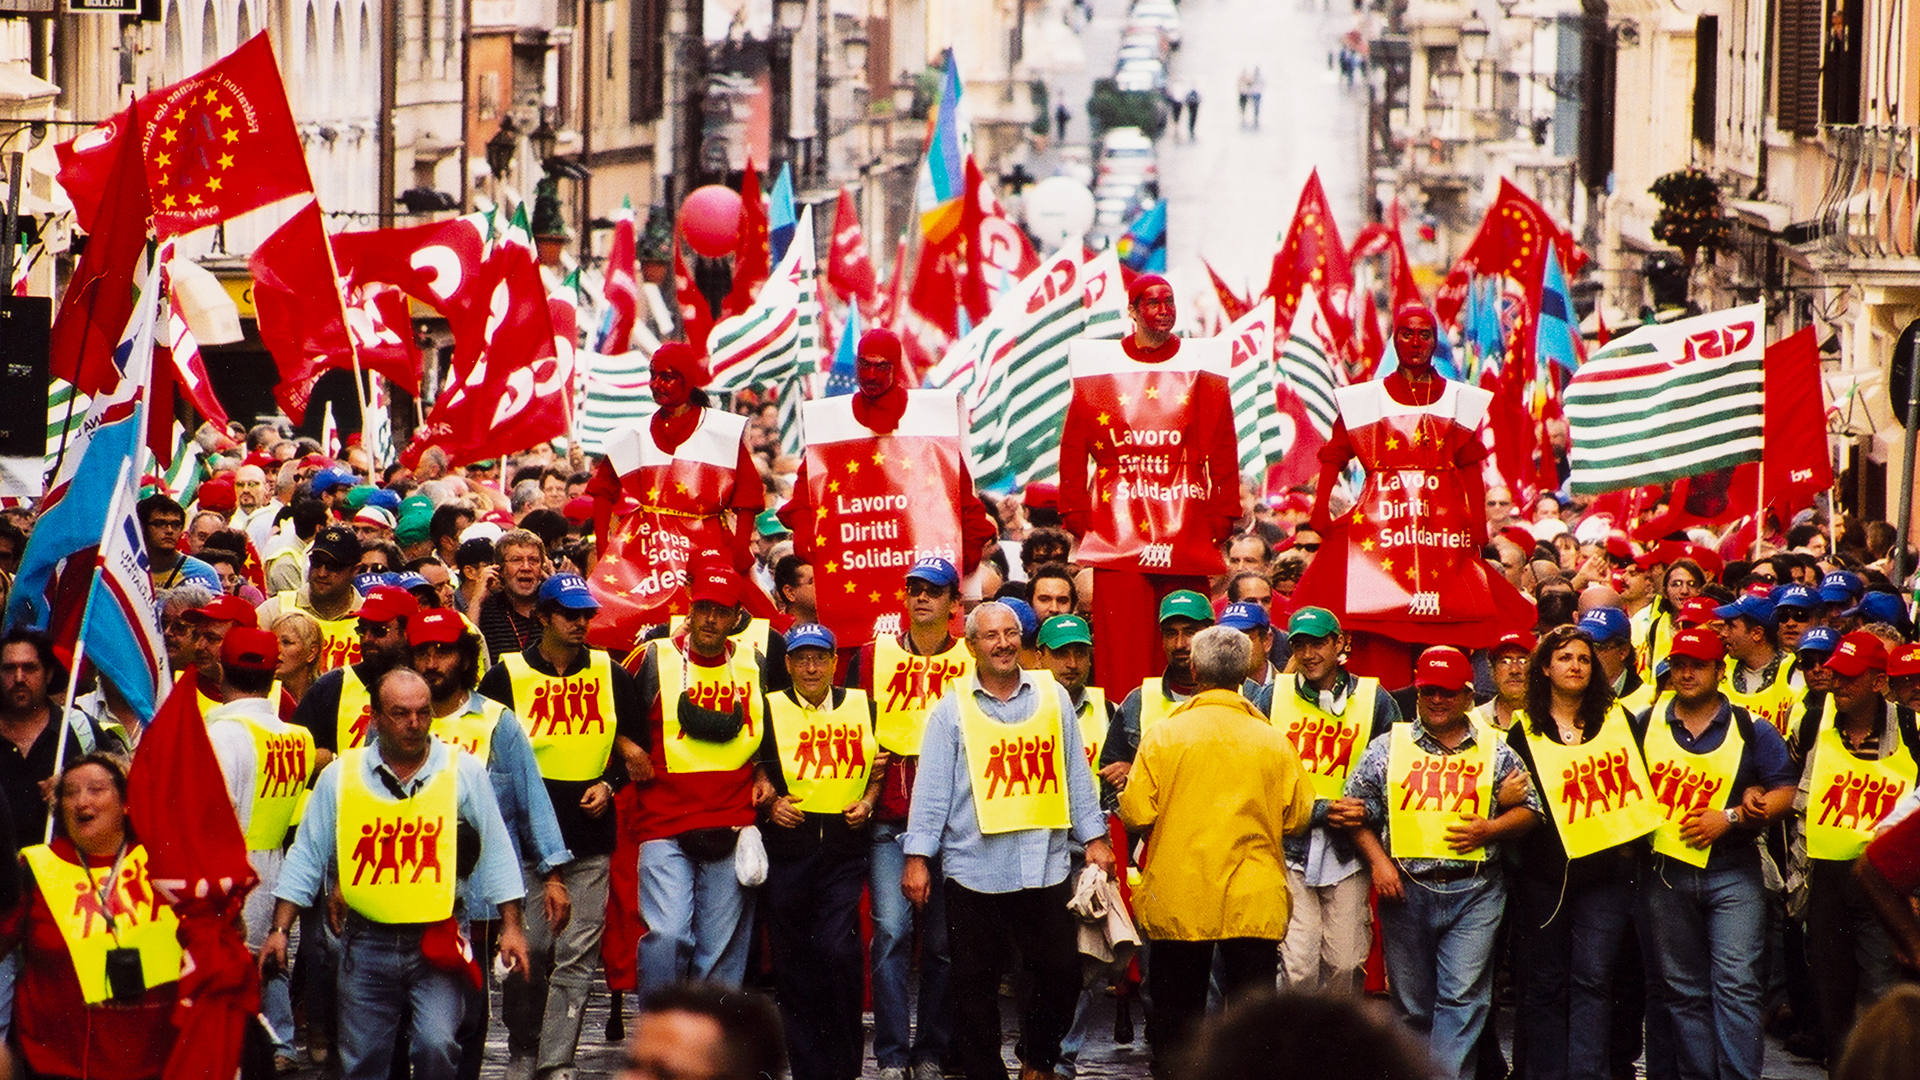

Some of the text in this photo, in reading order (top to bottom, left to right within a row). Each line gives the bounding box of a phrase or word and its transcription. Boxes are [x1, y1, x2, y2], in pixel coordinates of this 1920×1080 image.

[1109, 428, 1182, 447] Lavoro
[837, 494, 908, 515] Lavoro
[840, 519, 898, 543] Diritti
[842, 543, 956, 571] Solidarietà
[361, 575, 385, 584] UIL
[561, 578, 585, 587] UIL
[1826, 575, 1845, 583] UIL
[1787, 587, 1807, 595] UIL
[1225, 605, 1247, 614] UIL
[1586, 610, 1607, 620] UIL
[797, 625, 821, 634] UIL
[1807, 629, 1828, 638] UIL
